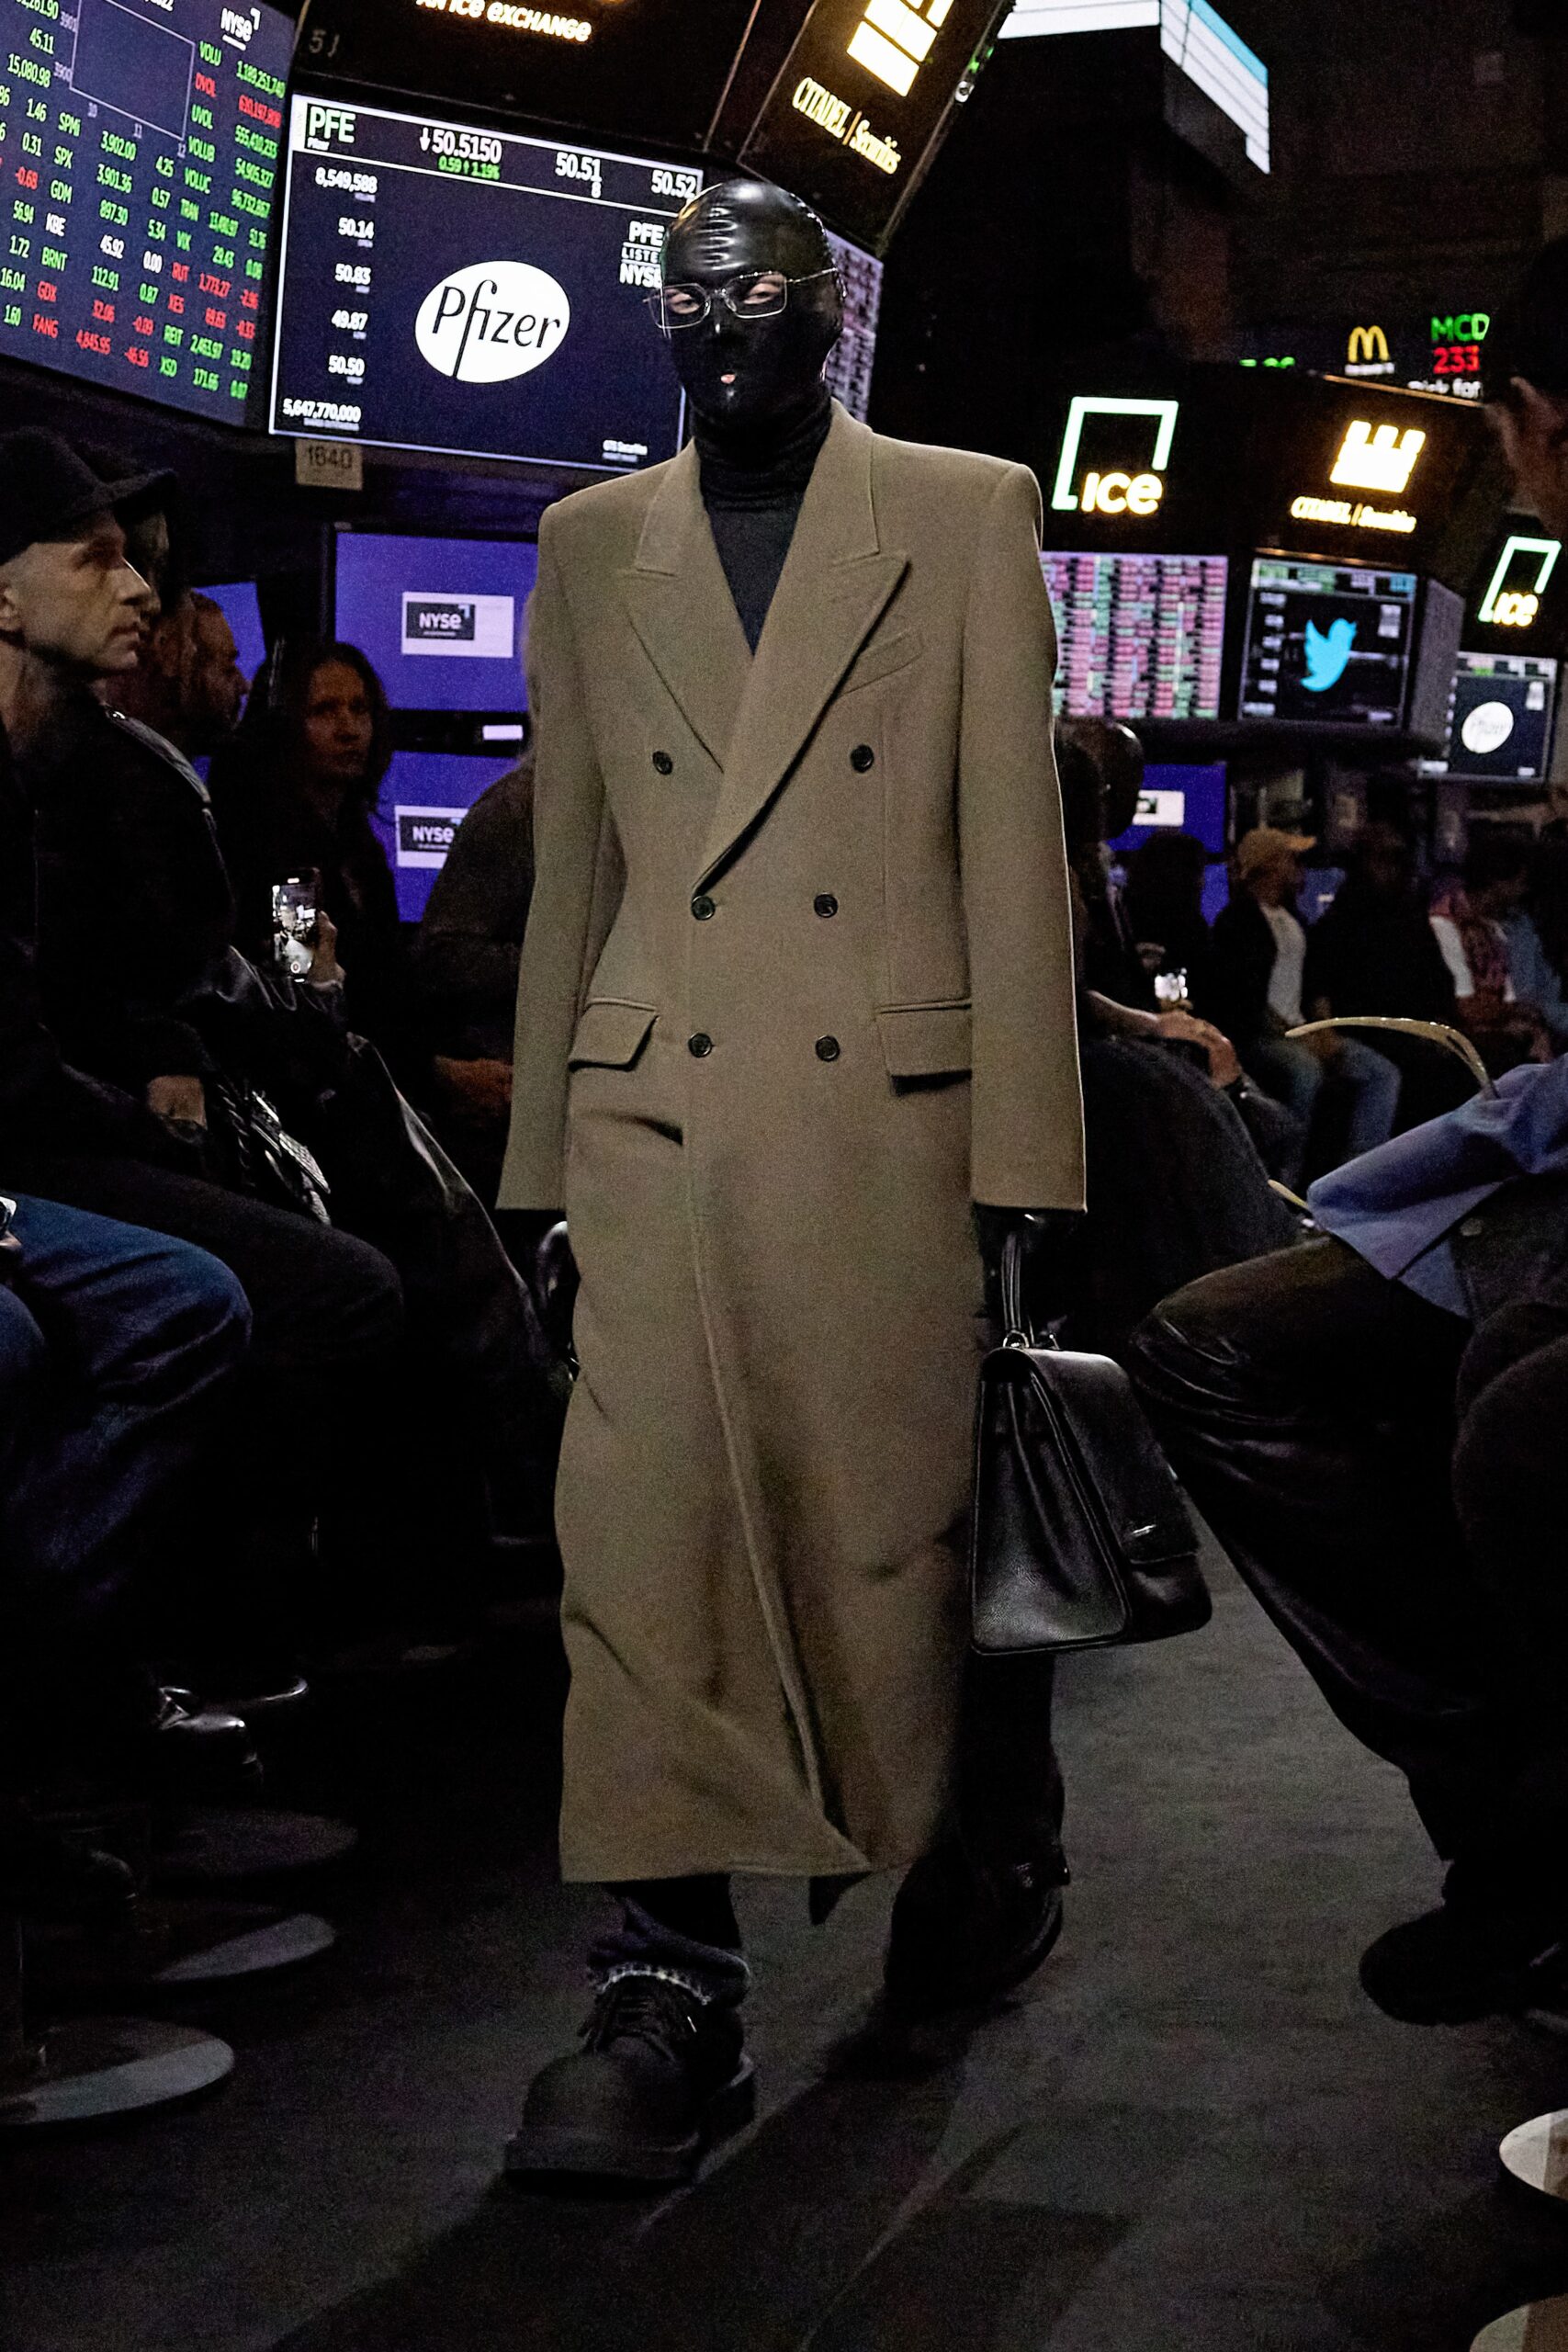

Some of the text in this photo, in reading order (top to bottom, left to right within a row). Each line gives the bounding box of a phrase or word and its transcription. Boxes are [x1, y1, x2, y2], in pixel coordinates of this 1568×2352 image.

[29, 28, 54, 55] 45.11
[199, 40, 221, 66] VOLU
[7, 53, 51, 88] 15,080.98
[792, 77, 852, 139] CITADEL
[26, 98, 48, 122] 1.46
[100, 130, 137, 162] 3,902.00
[309, 106, 356, 143] PFE
[432, 129, 502, 164] 50.5150
[555, 152, 602, 182] 50.51
[650, 169, 697, 199] 50.52
[438, 155, 462, 173] 0.59
[22, 132, 42, 157] 0.31
[53, 145, 73, 170] SPX
[96, 163, 132, 194] 3,901.36
[151, 187, 172, 209] 0.57
[315, 167, 378, 194] 8,549,588
[147, 219, 166, 242] 5.34
[338, 217, 374, 239] 50.14
[629, 220, 665, 247] PFE
[45, 212, 66, 237] KBE
[99, 234, 125, 259] 45.92
[142, 250, 164, 274] 0.00
[621, 246, 659, 264] LISTE
[9, 234, 30, 258] 1.72
[41, 246, 68, 272] BRNT
[91, 266, 120, 292] 112.91
[0, 267, 26, 292] 16.04
[32, 313, 59, 339] FANG
[332, 310, 367, 331] 49.87
[432, 278, 560, 379] Pfizer
[1431, 312, 1490, 342] MCD
[328, 355, 365, 377] 50.50
